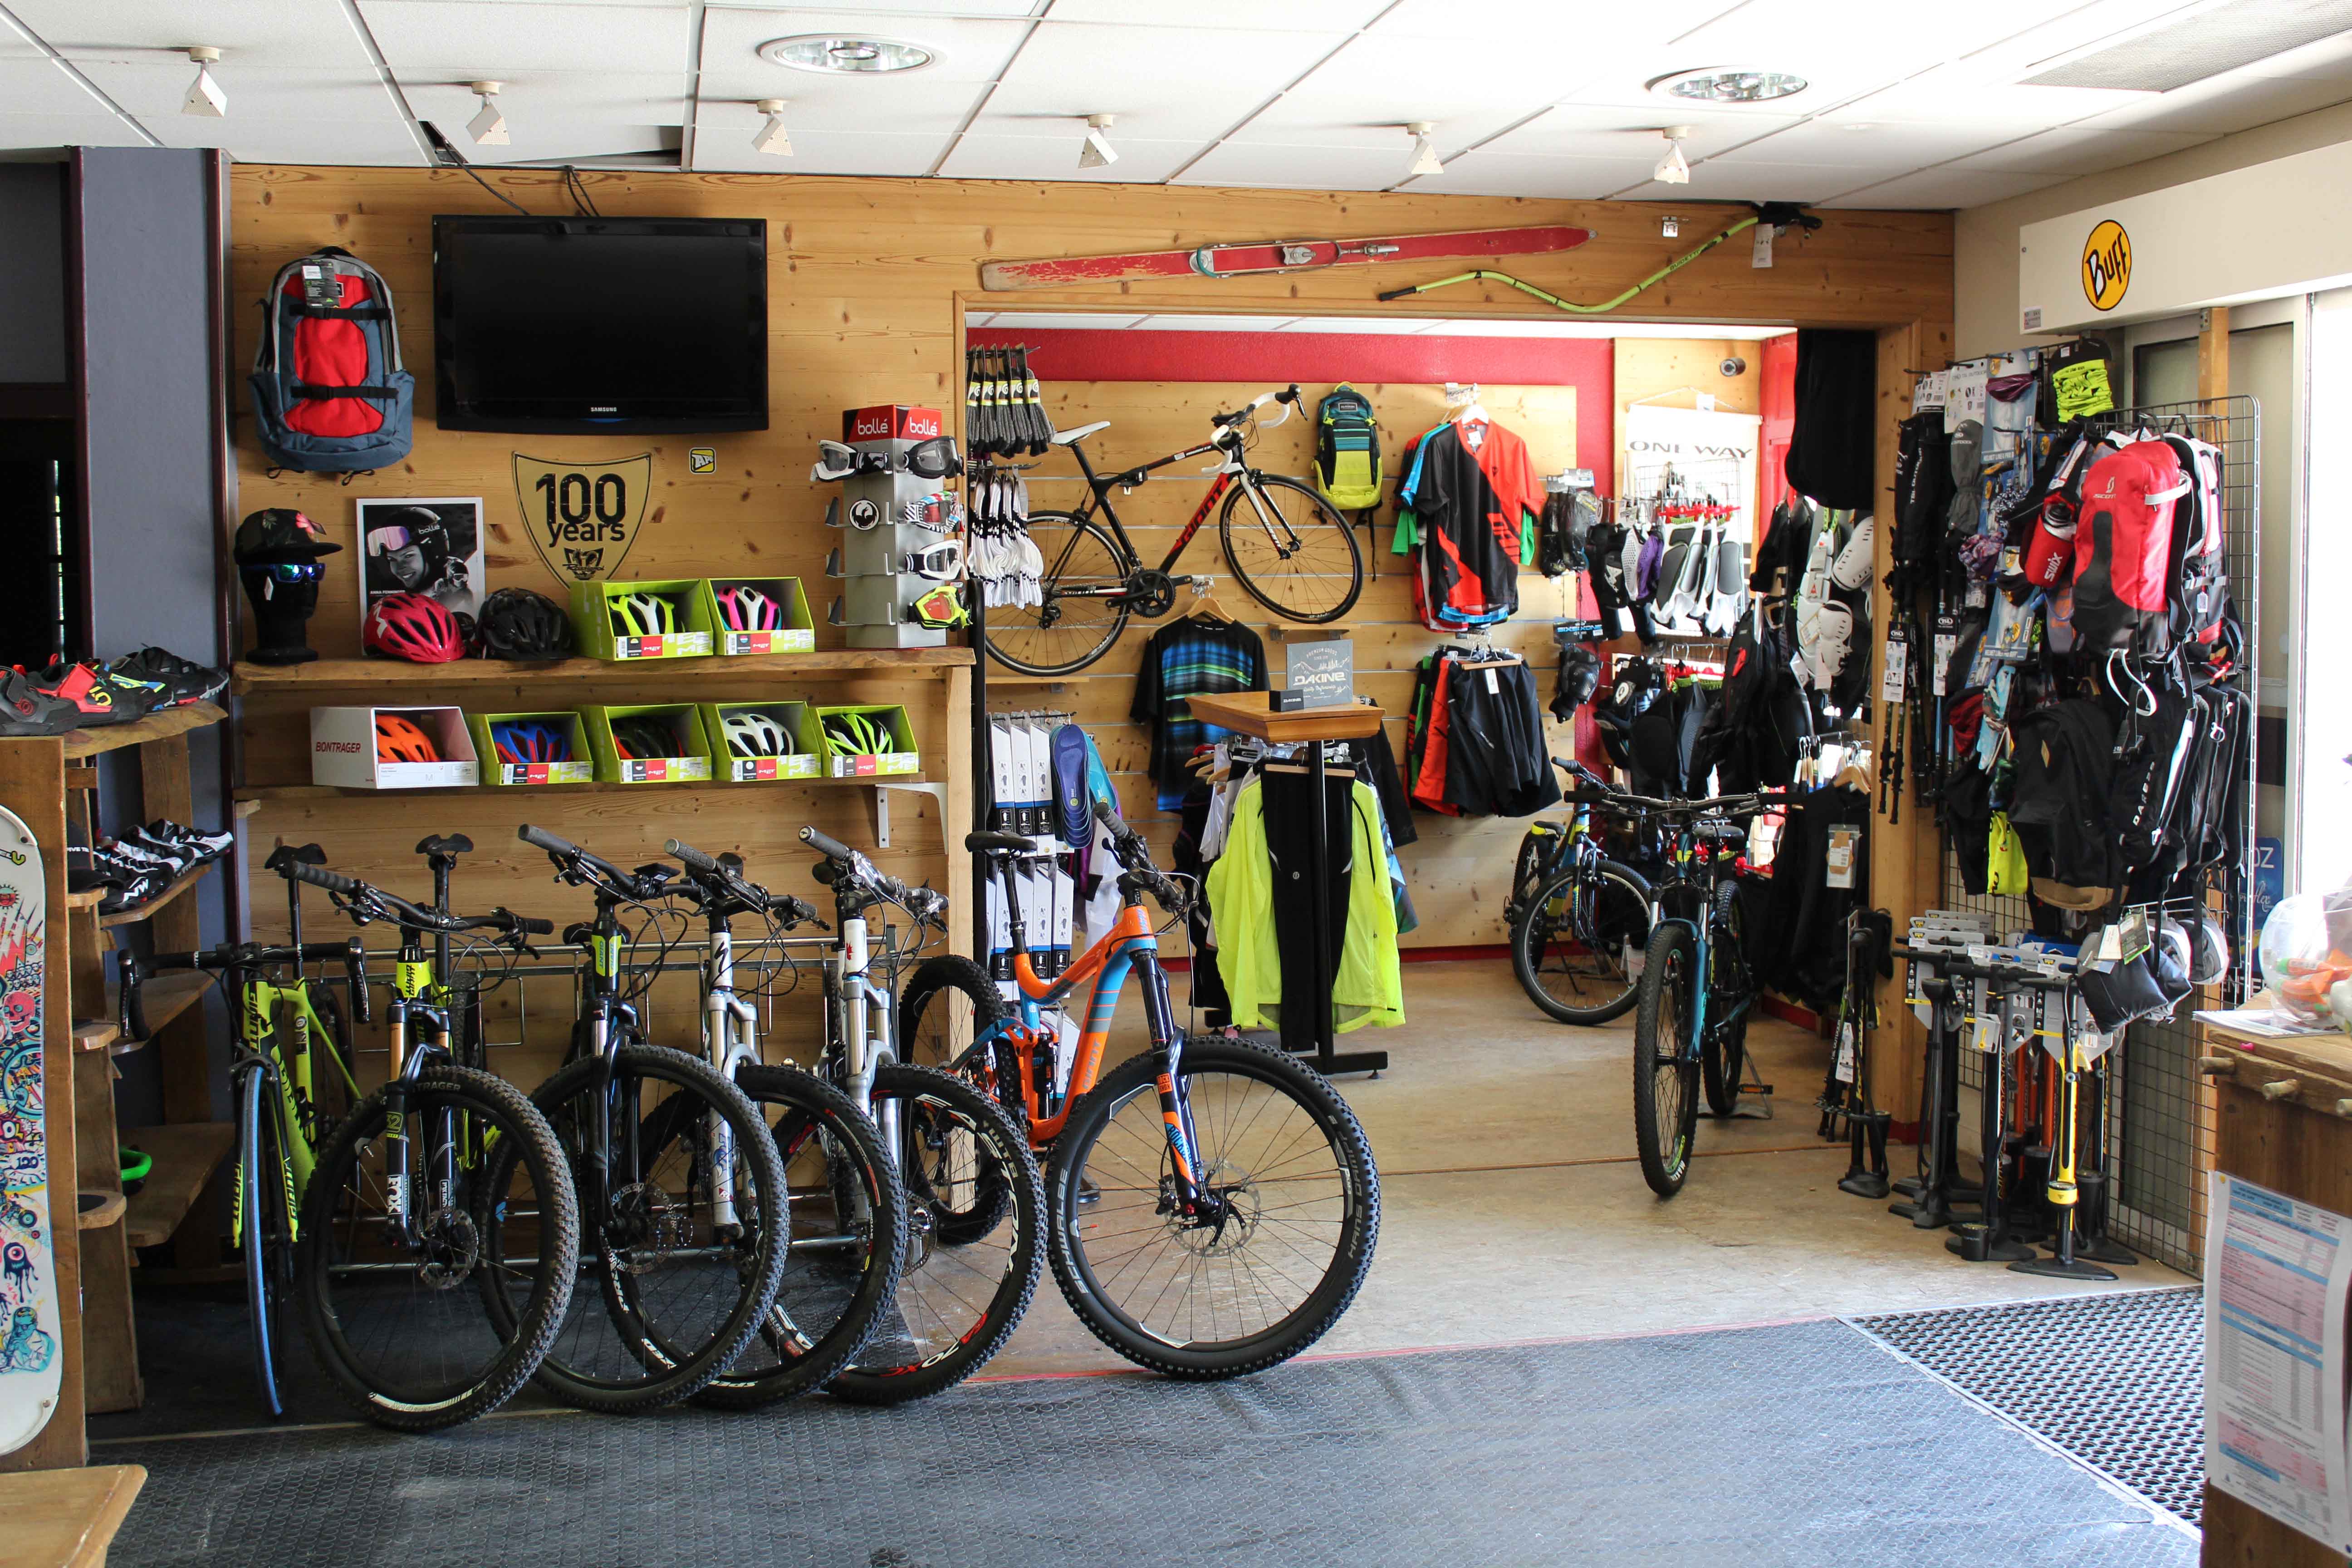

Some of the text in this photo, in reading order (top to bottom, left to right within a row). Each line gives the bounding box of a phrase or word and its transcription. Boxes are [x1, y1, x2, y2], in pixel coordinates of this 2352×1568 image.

[858, 418, 888, 435] bollé
[910, 416, 937, 436] bollé
[1695, 446, 1753, 458] WAY
[536, 473, 626, 524] 100
[1181, 481, 1224, 544] GIANT
[549, 523, 625, 547] years
[1293, 672, 1347, 686] DAKINE
[316, 742, 360, 753] BONTRAGER
[1082, 1038, 1102, 1089] GIANT
[415, 1082, 461, 1093] TRAGER
[989, 1127, 1019, 1178] WTB
[1338, 1131, 1362, 1197] DAMPF
[388, 1176, 402, 1213] FOX
[915, 1094, 1019, 1273] EASTON
[1057, 1168, 1089, 1294] SCHWALBE
[1348, 1204, 1362, 1259] HANS
[766, 1310, 784, 1336] UBELESS
